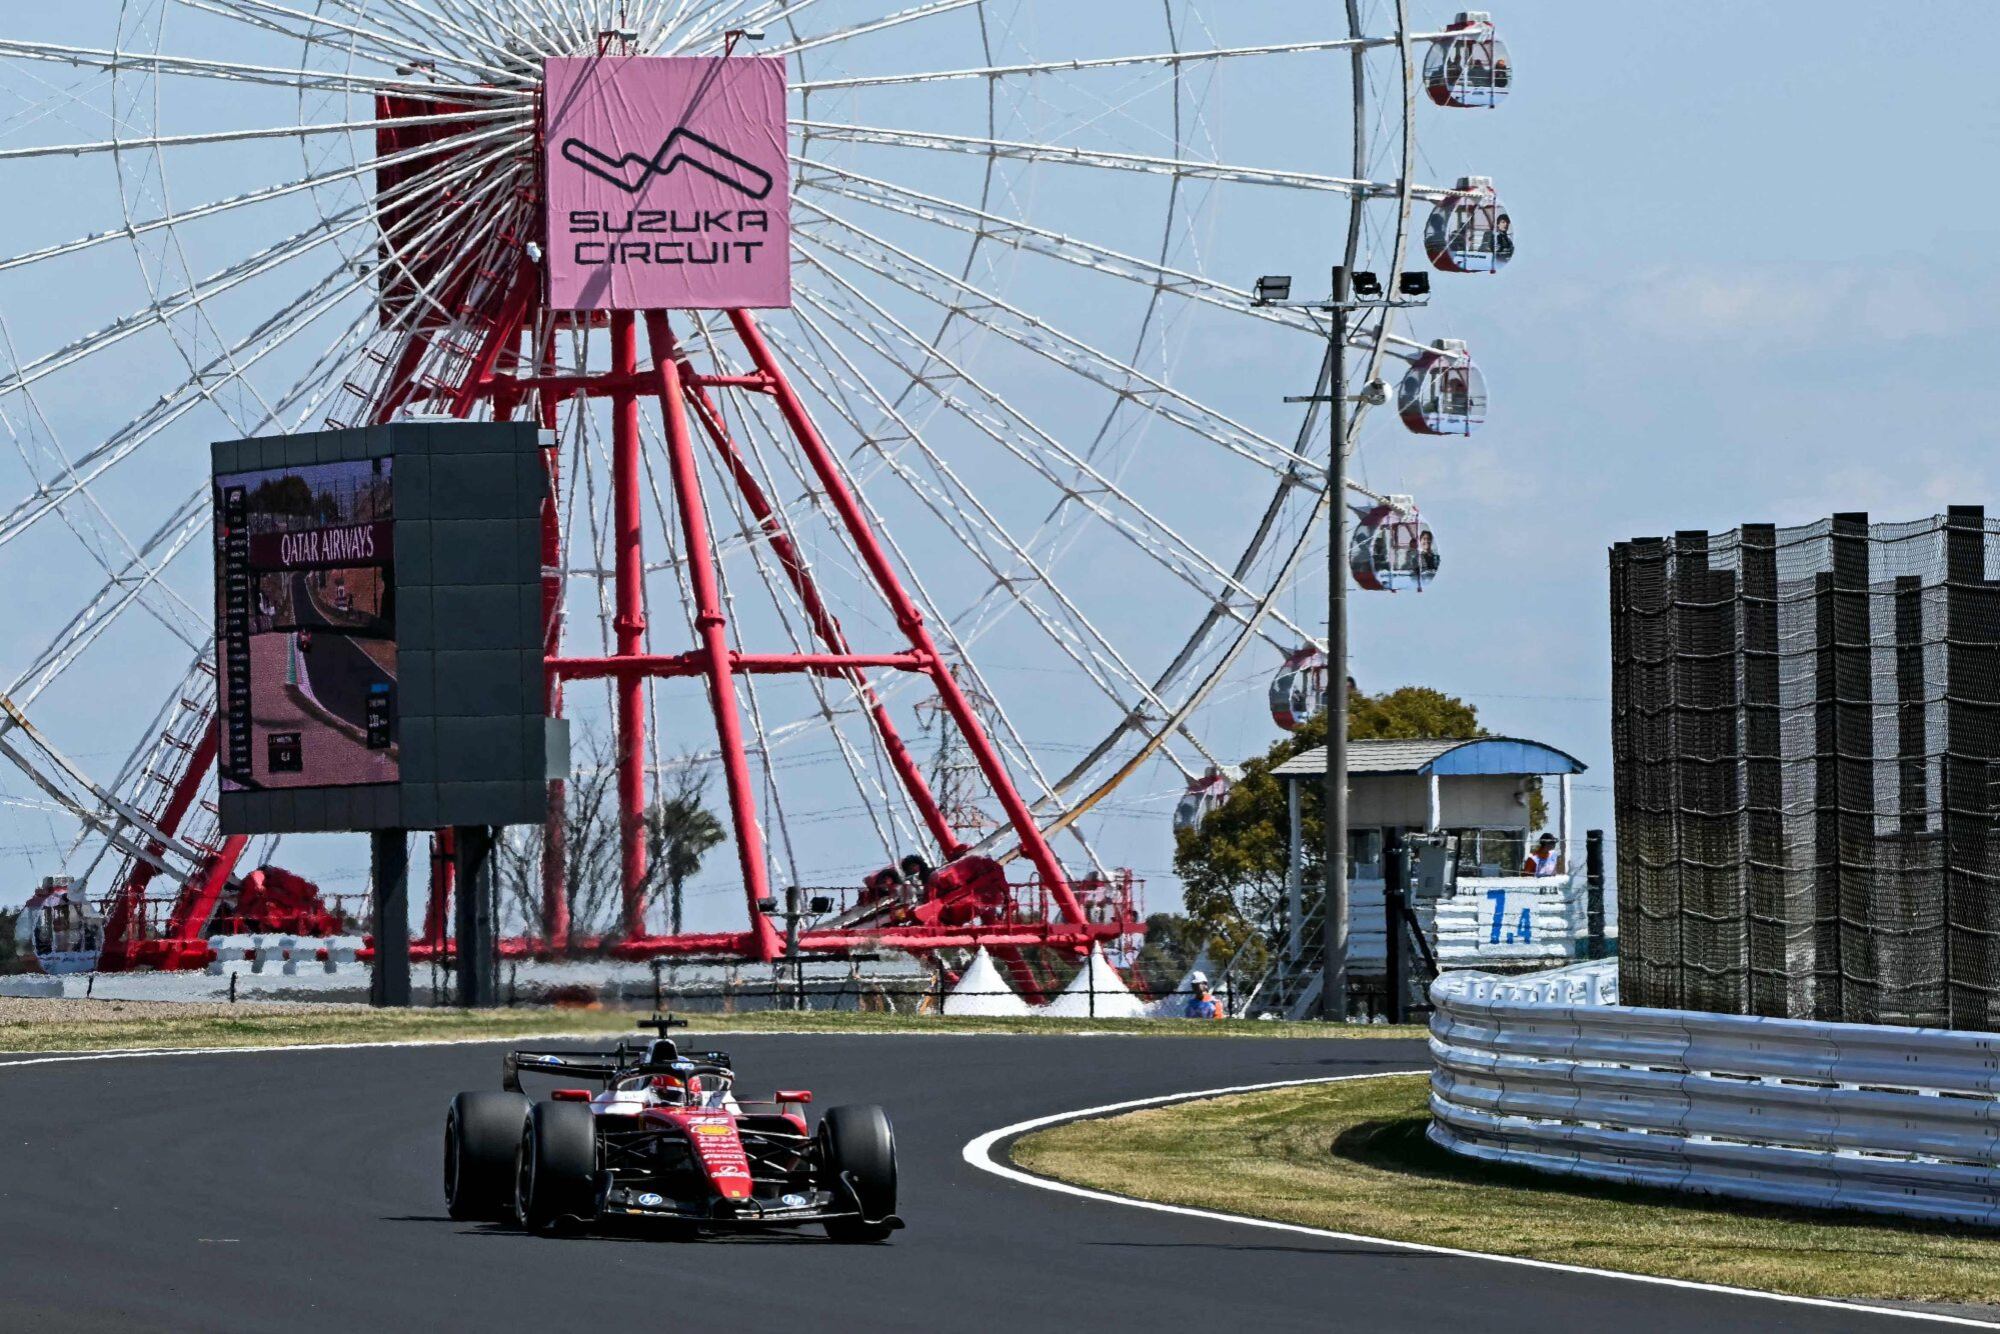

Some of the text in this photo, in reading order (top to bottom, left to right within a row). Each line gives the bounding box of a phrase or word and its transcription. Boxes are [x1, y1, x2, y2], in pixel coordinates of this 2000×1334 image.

[569, 210, 768, 233] SUZUKA
[574, 242, 763, 265] CIRCUIT
[281, 525, 374, 566] QATAR AIRWAYS
[1487, 889, 1532, 944] 7.4
